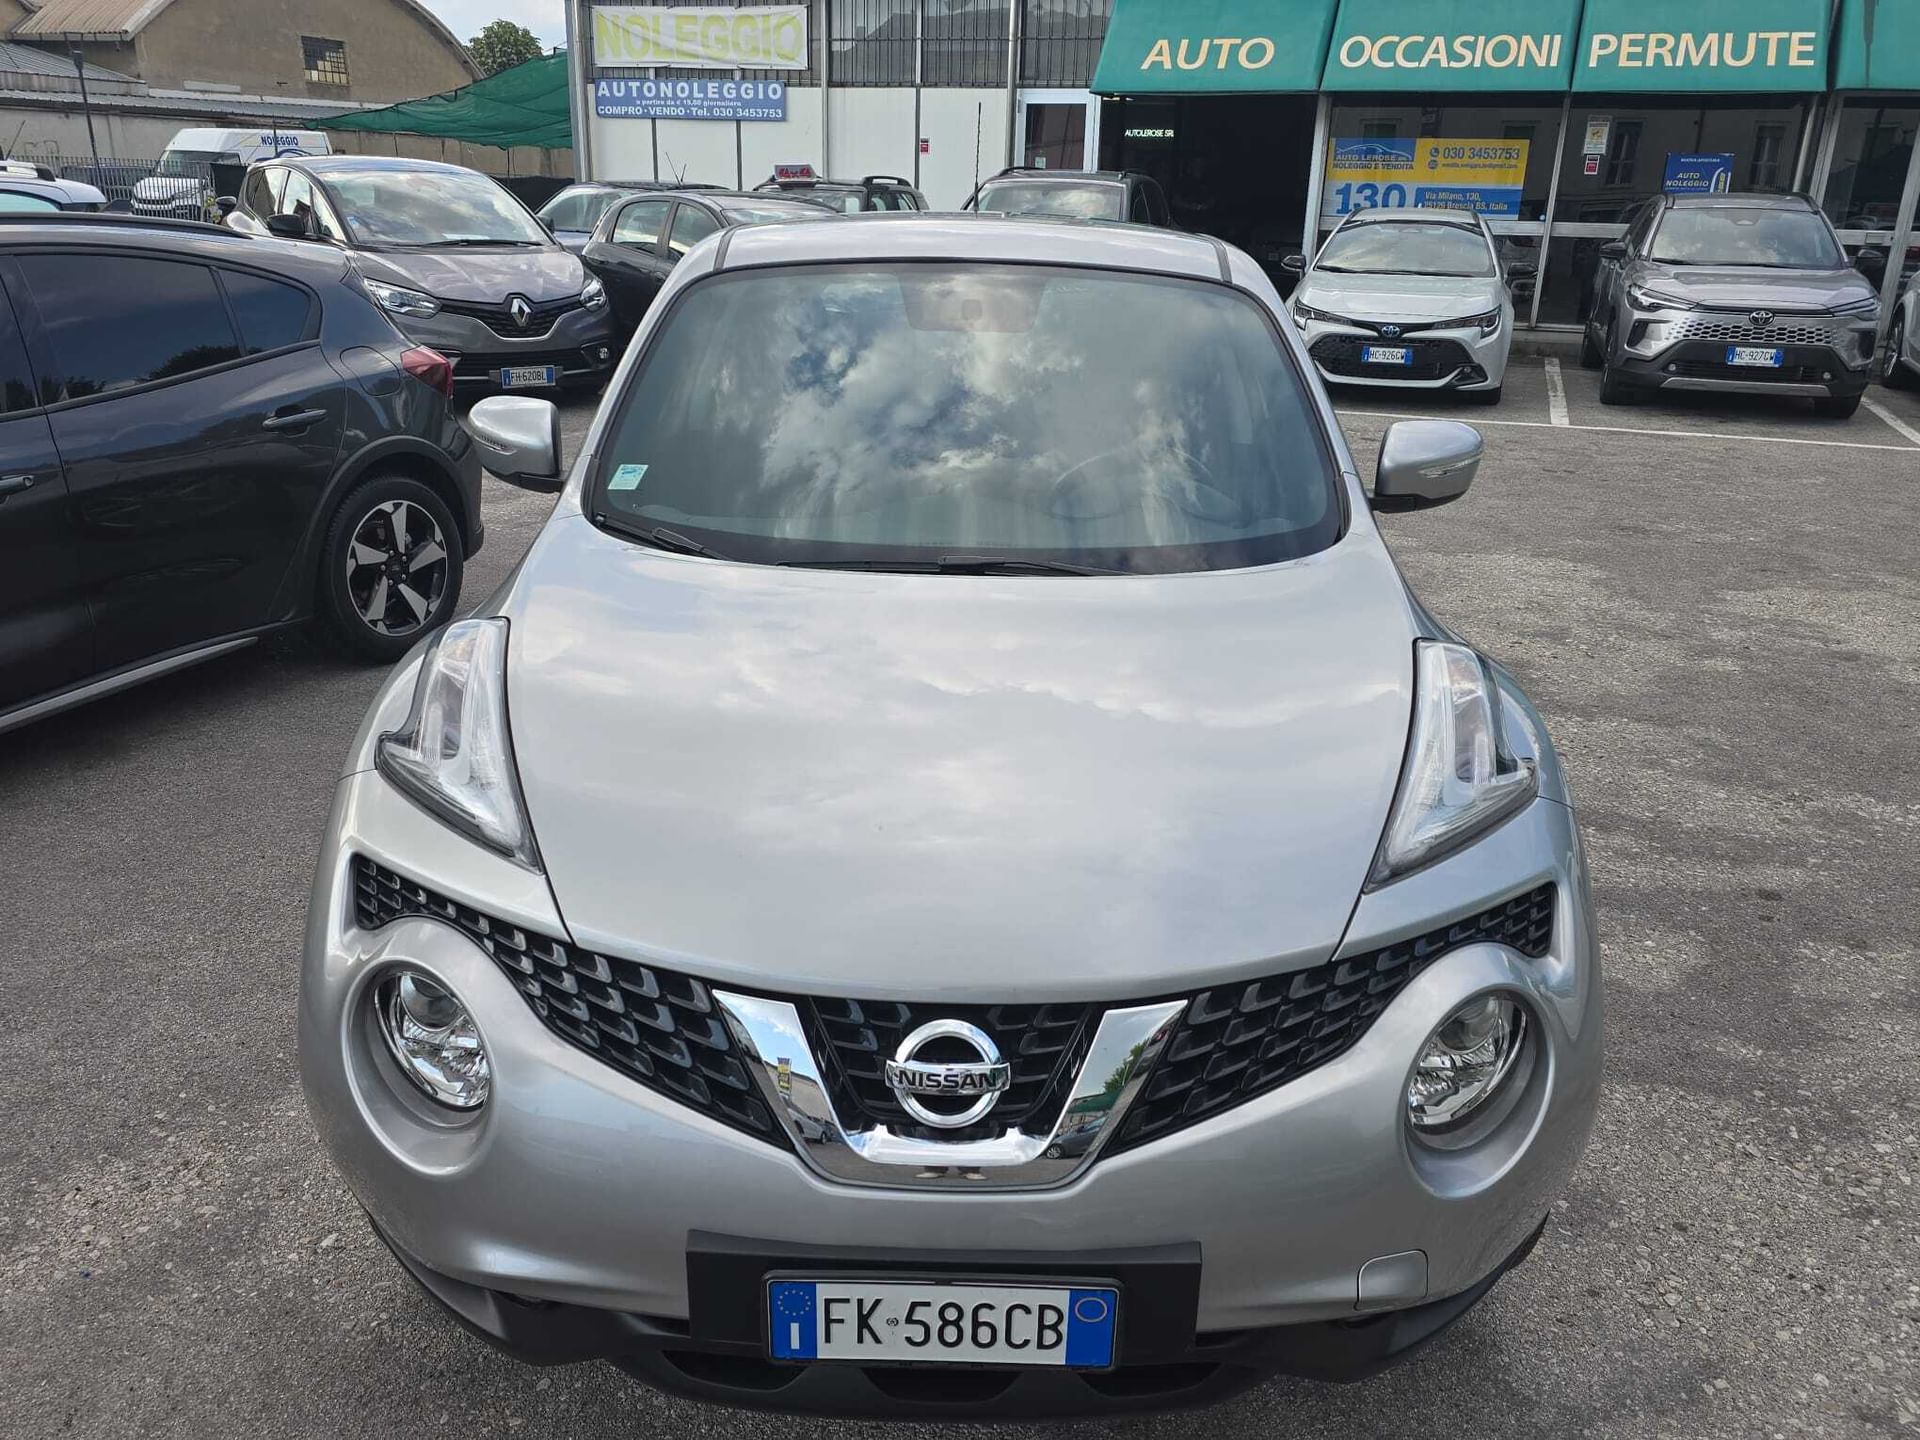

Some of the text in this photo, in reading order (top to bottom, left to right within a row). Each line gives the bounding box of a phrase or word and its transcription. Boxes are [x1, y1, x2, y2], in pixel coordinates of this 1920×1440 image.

[596, 14, 801, 61] NOLEGGIO
[1140, 32, 1816, 70] AUTO OCCASIONI PERMUTE
[598, 81, 783, 100] AUTONOLEGGIO
[598, 106, 783, 118] COMPRO VENDO Tel. 030 3453753
[1442, 147, 1520, 161] 030 3453753
[1333, 162, 1373, 170] NOLEGGIO
[1335, 183, 1407, 214] 130
[1425, 192, 1436, 200] Via
[898, 1069, 998, 1089] NISSAN
